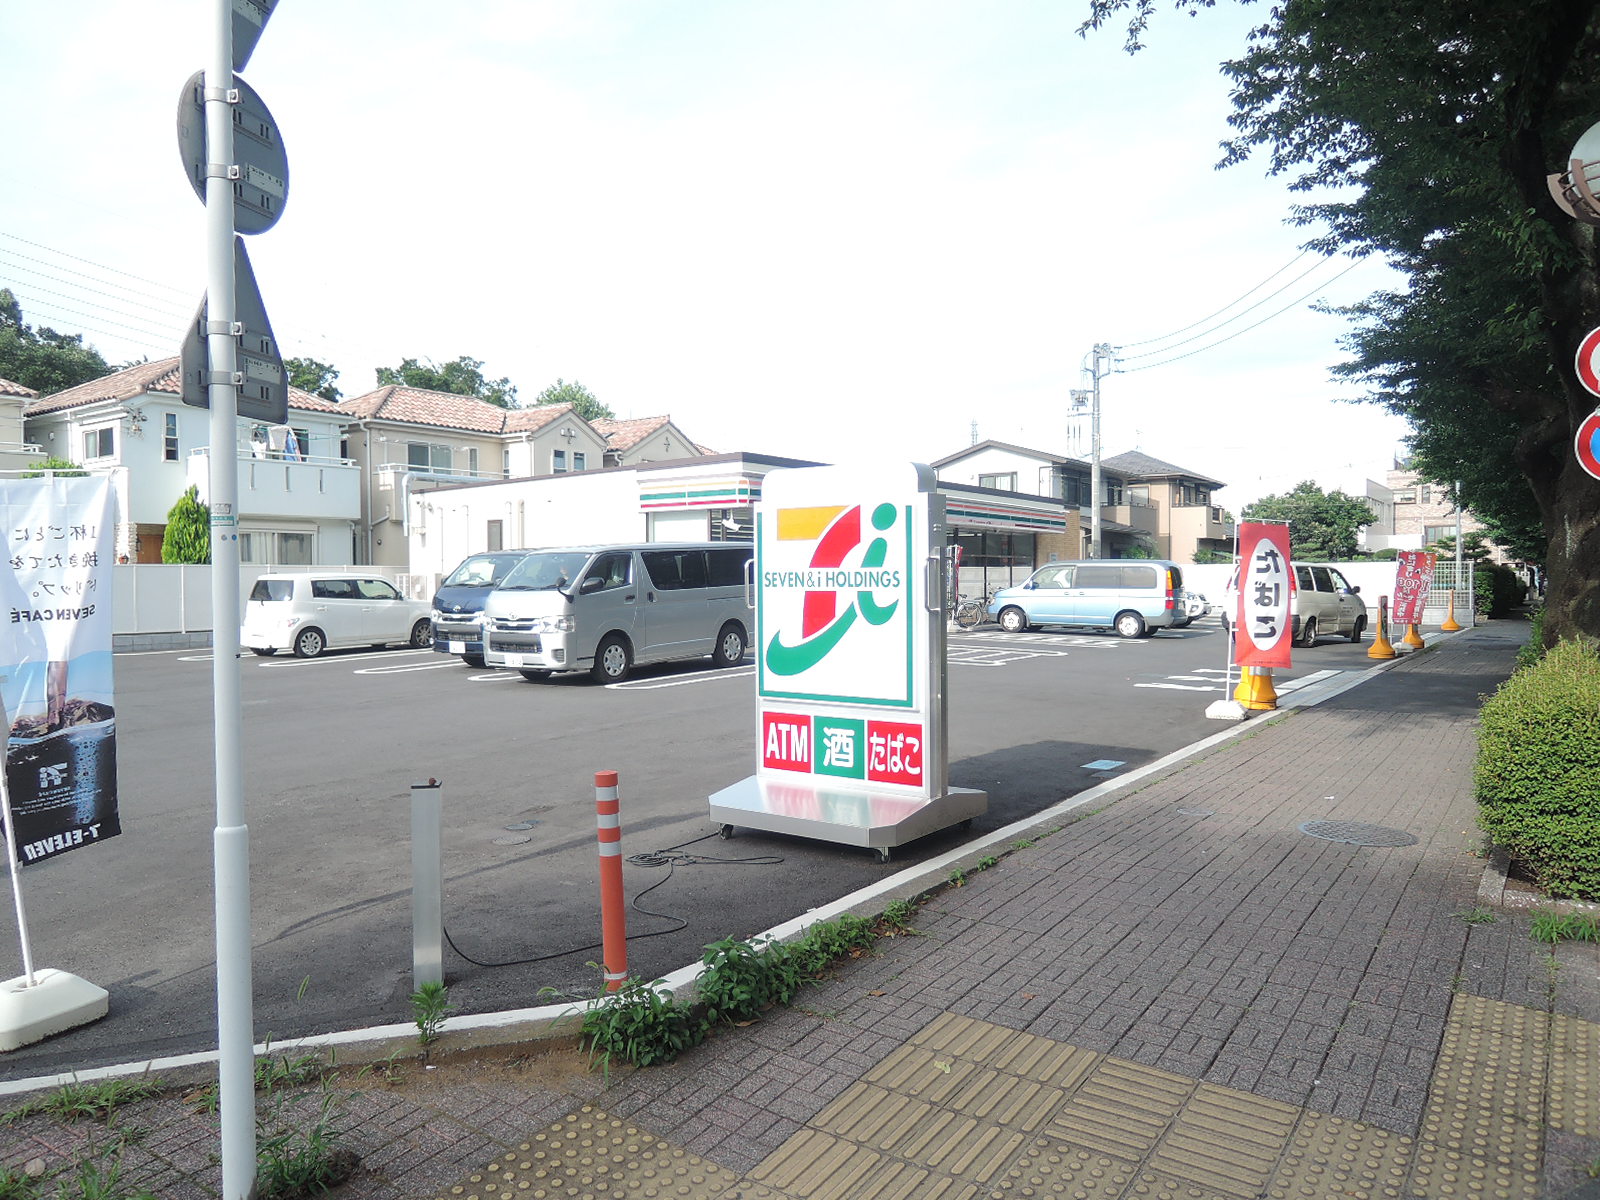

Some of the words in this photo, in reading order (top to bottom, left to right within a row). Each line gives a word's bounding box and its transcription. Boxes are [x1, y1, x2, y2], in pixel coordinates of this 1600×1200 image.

[826, 571, 900, 588] HOLDINGS
[766, 722, 808, 763] ATM
[822, 727, 855, 768] 酒
[869, 731, 921, 775] たばこ
